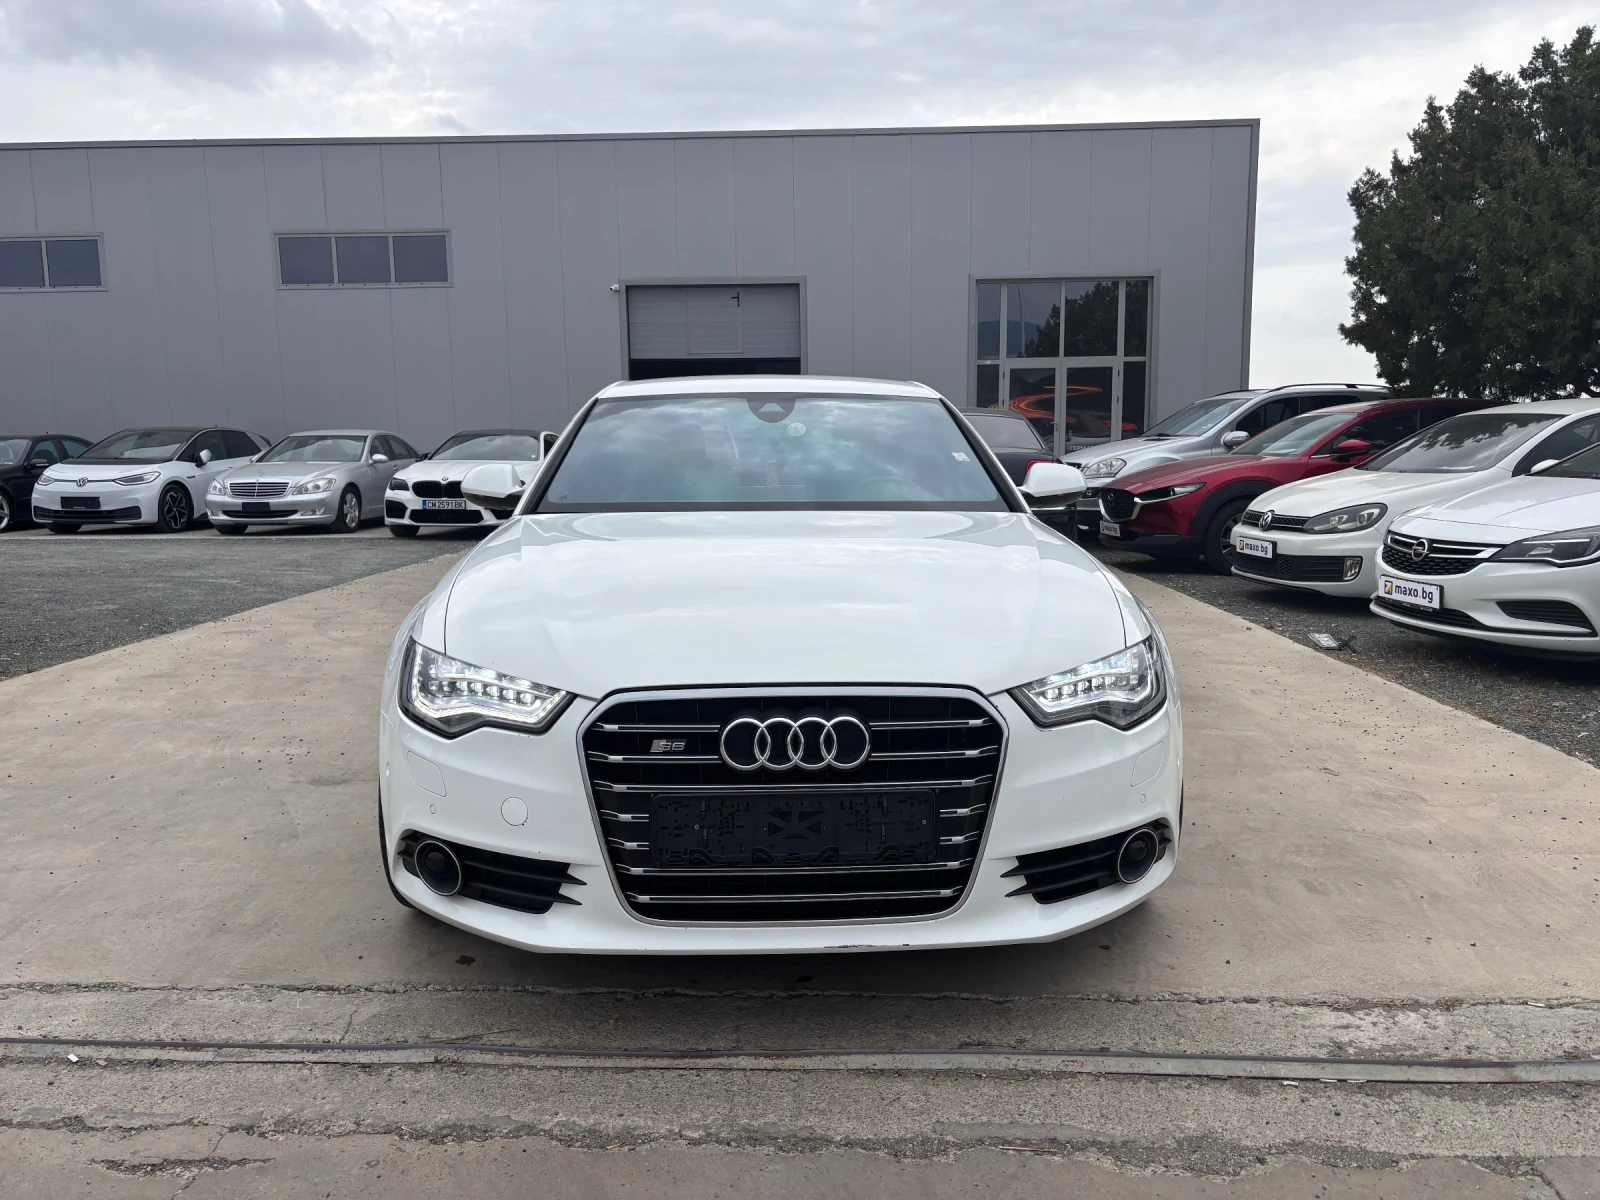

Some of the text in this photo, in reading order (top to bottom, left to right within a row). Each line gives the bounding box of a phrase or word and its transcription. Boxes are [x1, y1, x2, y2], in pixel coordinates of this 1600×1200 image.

[437, 501, 454, 509] 2591
[1244, 542, 1268, 556] maxo.bg
[1395, 584, 1434, 604] maxo.bg
[657, 741, 686, 751] S6
